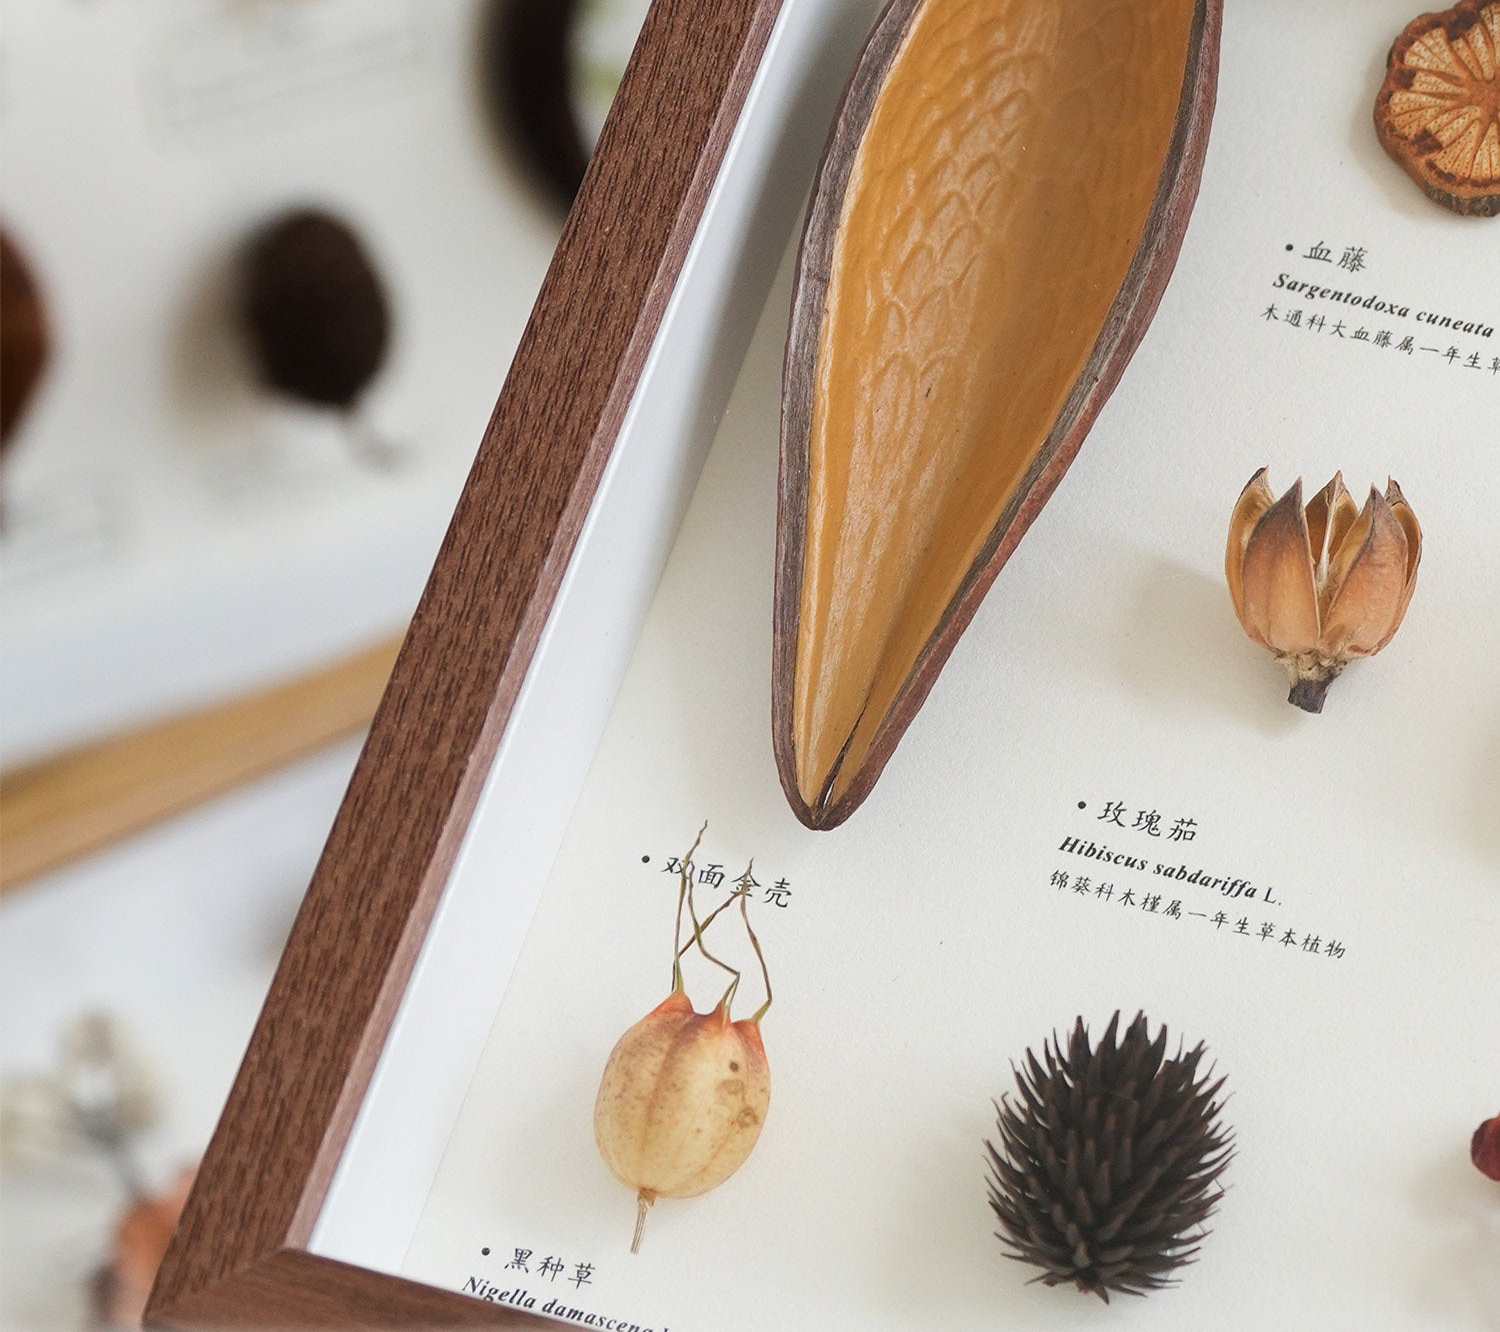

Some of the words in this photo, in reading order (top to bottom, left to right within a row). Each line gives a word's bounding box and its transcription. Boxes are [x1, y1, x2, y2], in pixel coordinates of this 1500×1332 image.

[1303, 240, 1368, 273] 血藤
[1272, 273, 1410, 318] Sargentodoxa
[1416, 310, 1495, 338] cuneata
[1097, 801, 1198, 843] 玫瑰茄
[1058, 836, 1148, 872] Hibiscus
[1152, 862, 1258, 899] sabdariffa
[1263, 888, 1282, 906] L.
[504, 1247, 596, 1290] 黑种草
[462, 1276, 537, 1310] Nigella
